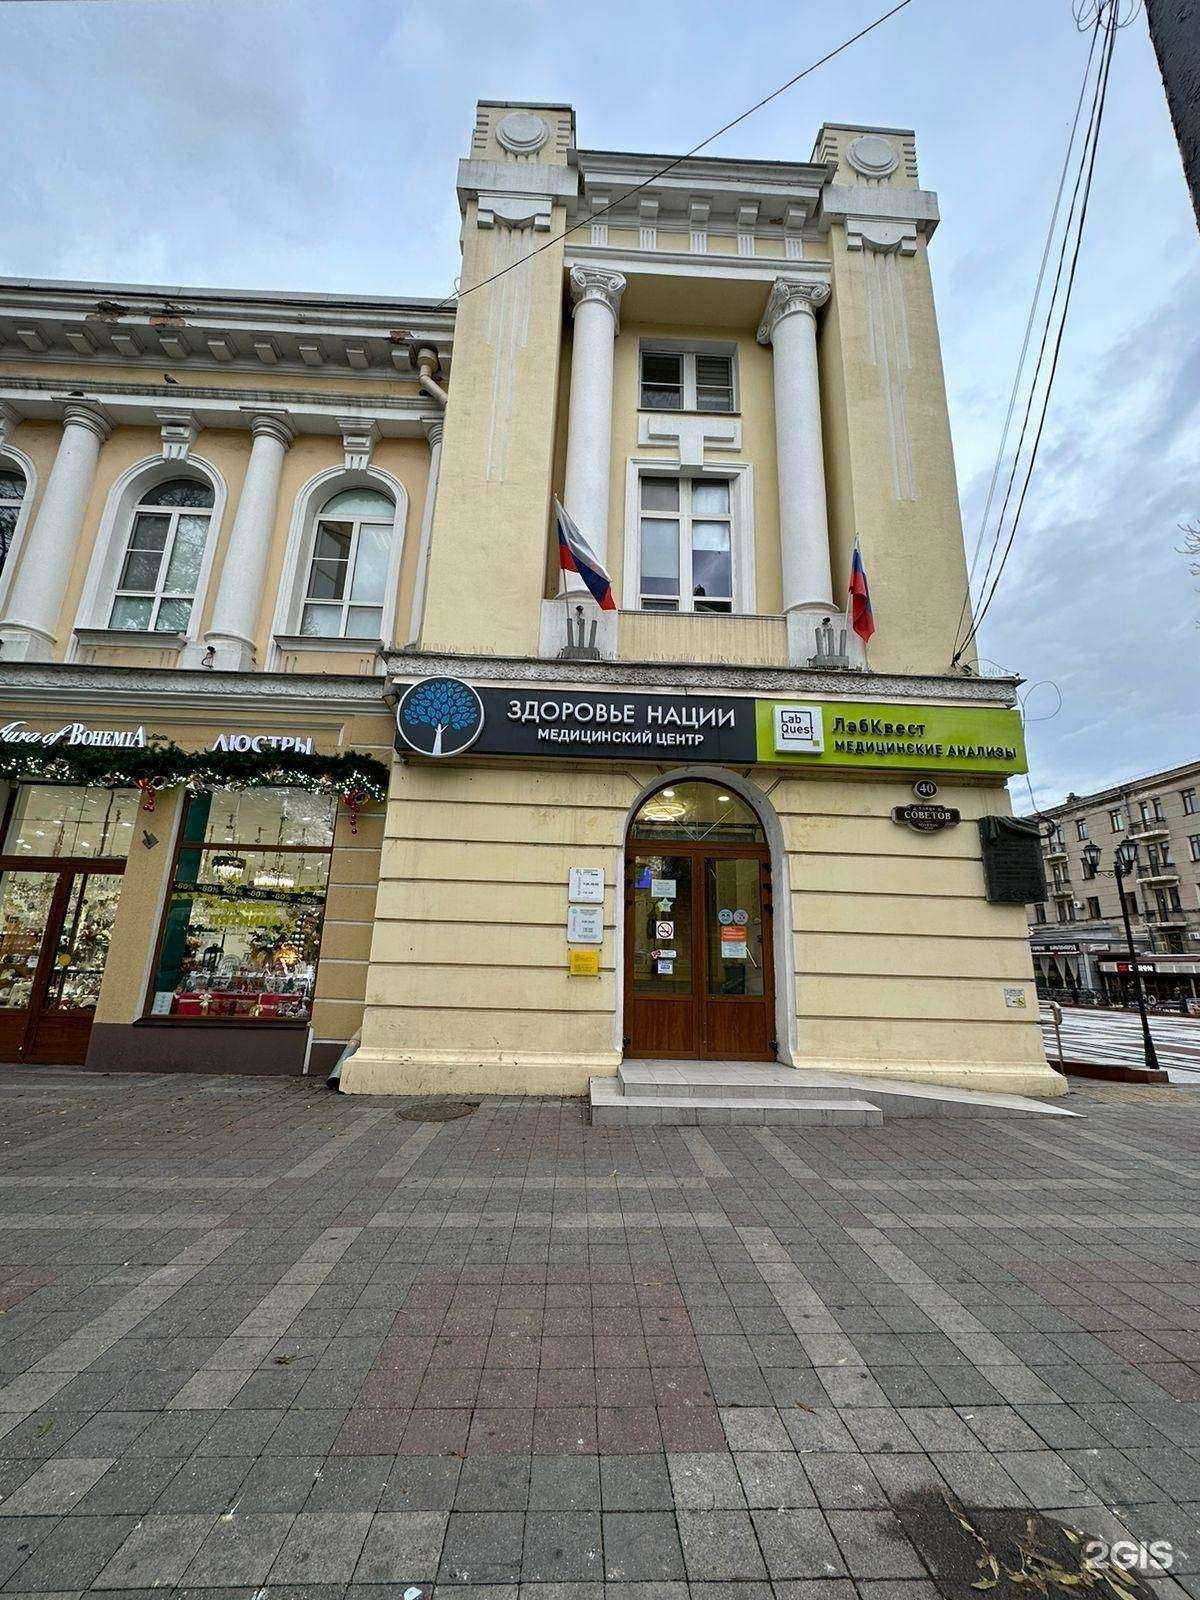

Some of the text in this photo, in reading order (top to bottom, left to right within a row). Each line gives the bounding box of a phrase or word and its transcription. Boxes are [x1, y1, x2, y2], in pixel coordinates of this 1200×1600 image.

[507, 700, 736, 729] ЗДОРОВЬЕ НАЦИИ
[781, 713, 802, 724] Lab
[42, 724, 74, 748] of
[781, 723, 814, 735] Quest
[832, 717, 926, 736] ЛабКвест
[211, 733, 313, 755] ЛЮСТРЫ
[537, 727, 705, 747] МЕДИЦИНСКИЙ ЦЕНТР
[833, 739, 1017, 760] МЕДИЦИНСКИЕ АНАЛИЗЫ
[919, 782, 934, 794] 40
[904, 811, 951, 820] СОВЕТОВ
